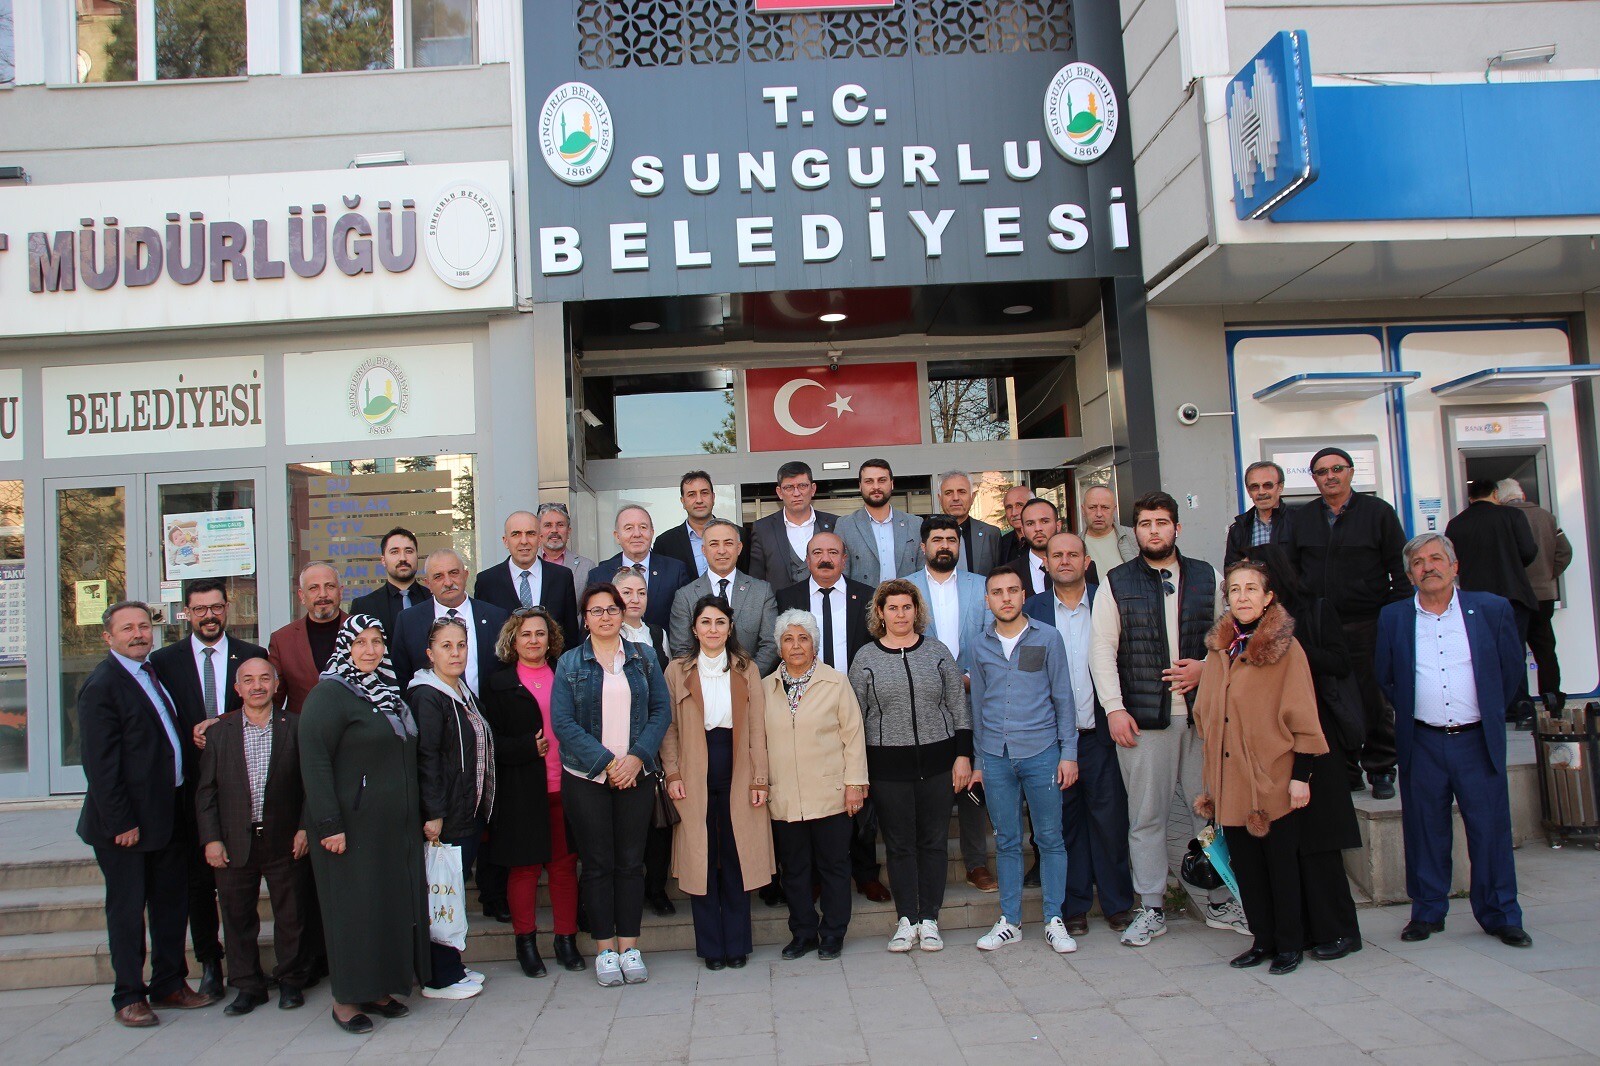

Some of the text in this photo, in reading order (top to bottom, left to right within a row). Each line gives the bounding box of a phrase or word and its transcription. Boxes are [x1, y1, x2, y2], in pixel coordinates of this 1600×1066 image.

[542, 86, 610, 157] SUNGURLU BELEDİYESİ
[1049, 66, 1116, 135] SUNGURLU BELEDİYESİ
[566, 166, 592, 176] 1866
[629, 140, 1043, 196] SUNGURLU
[1073, 146, 1099, 156] 1866
[429, 193, 456, 236] SUNGURLU
[539, 186, 1131, 277] BELEDİYESİ
[27, 194, 418, 293] MÜDÜRLÜĞÜ
[66, 369, 263, 436] BELEDİYESİ
[349, 358, 373, 417] SUNGURLU
[368, 425, 393, 435] 1866
[326, 478, 350, 493] SU
[328, 497, 391, 514] EMLAK
[326, 520, 364, 536] ÇTV
